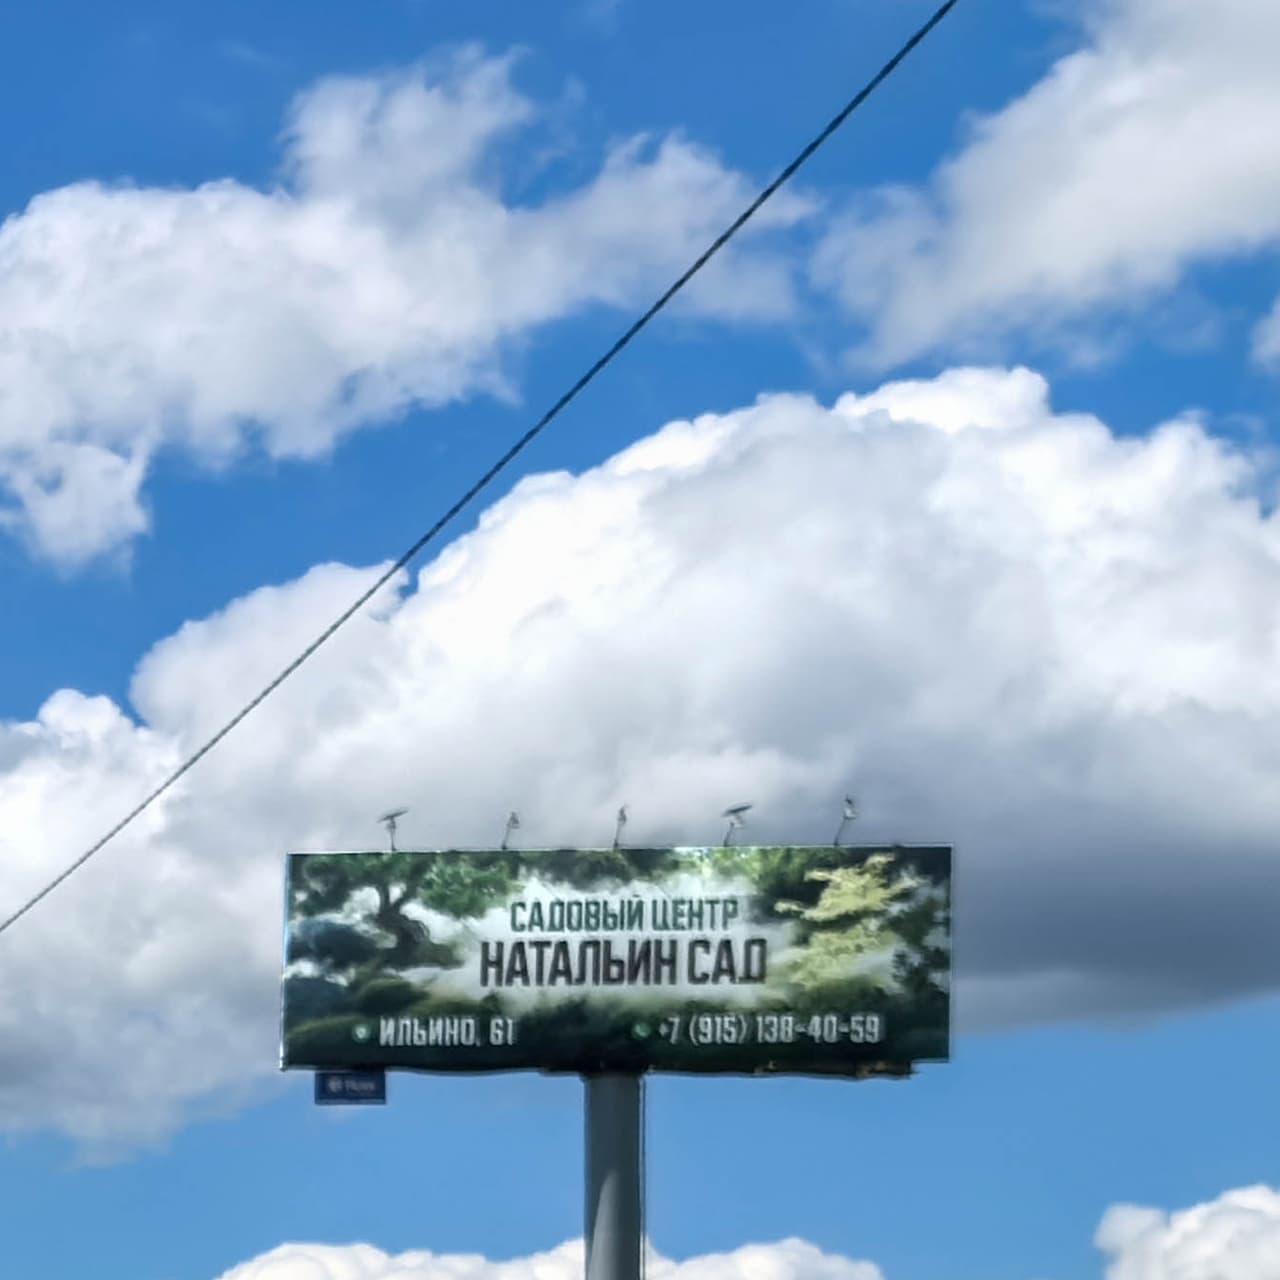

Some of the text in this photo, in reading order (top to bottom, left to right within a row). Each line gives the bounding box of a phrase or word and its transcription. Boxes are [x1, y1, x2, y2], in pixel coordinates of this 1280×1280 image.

[510, 895, 739, 932] САДОВЫЙ ЦЕНТР
[479, 938, 768, 987] НАТАЛЬИН САД
[379, 1016, 513, 1047] ИЛЬИНО, 61
[658, 1016, 680, 1044] +7
[690, 1014, 747, 1045] (915)
